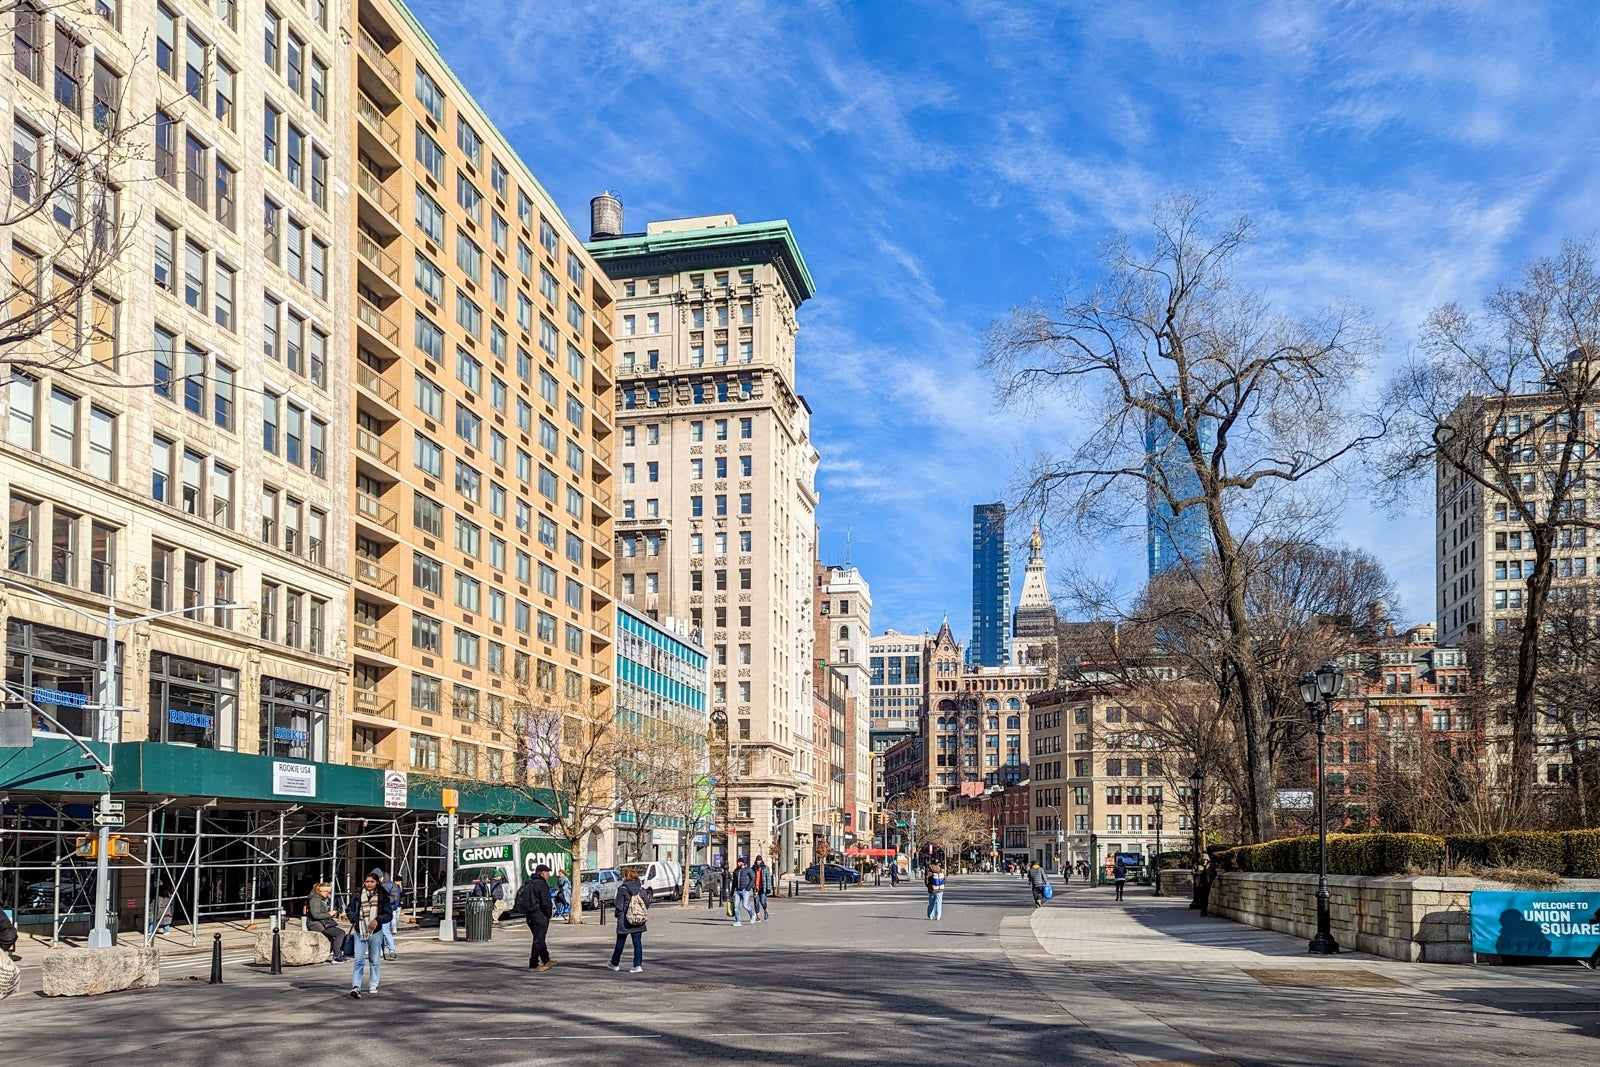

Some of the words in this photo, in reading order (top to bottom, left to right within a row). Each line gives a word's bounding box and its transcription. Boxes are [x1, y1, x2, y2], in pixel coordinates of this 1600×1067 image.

[34, 686, 88, 708] ROOKIE
[169, 709, 211, 728] ROOKIE
[274, 727, 307, 742] ROOKIE
[279, 763, 299, 773] ROOKIE
[300, 766, 312, 774] USA
[462, 846, 504, 861] GROW
[1523, 910, 1571, 923] UNION
[1541, 923, 1600, 937] SQUARE
